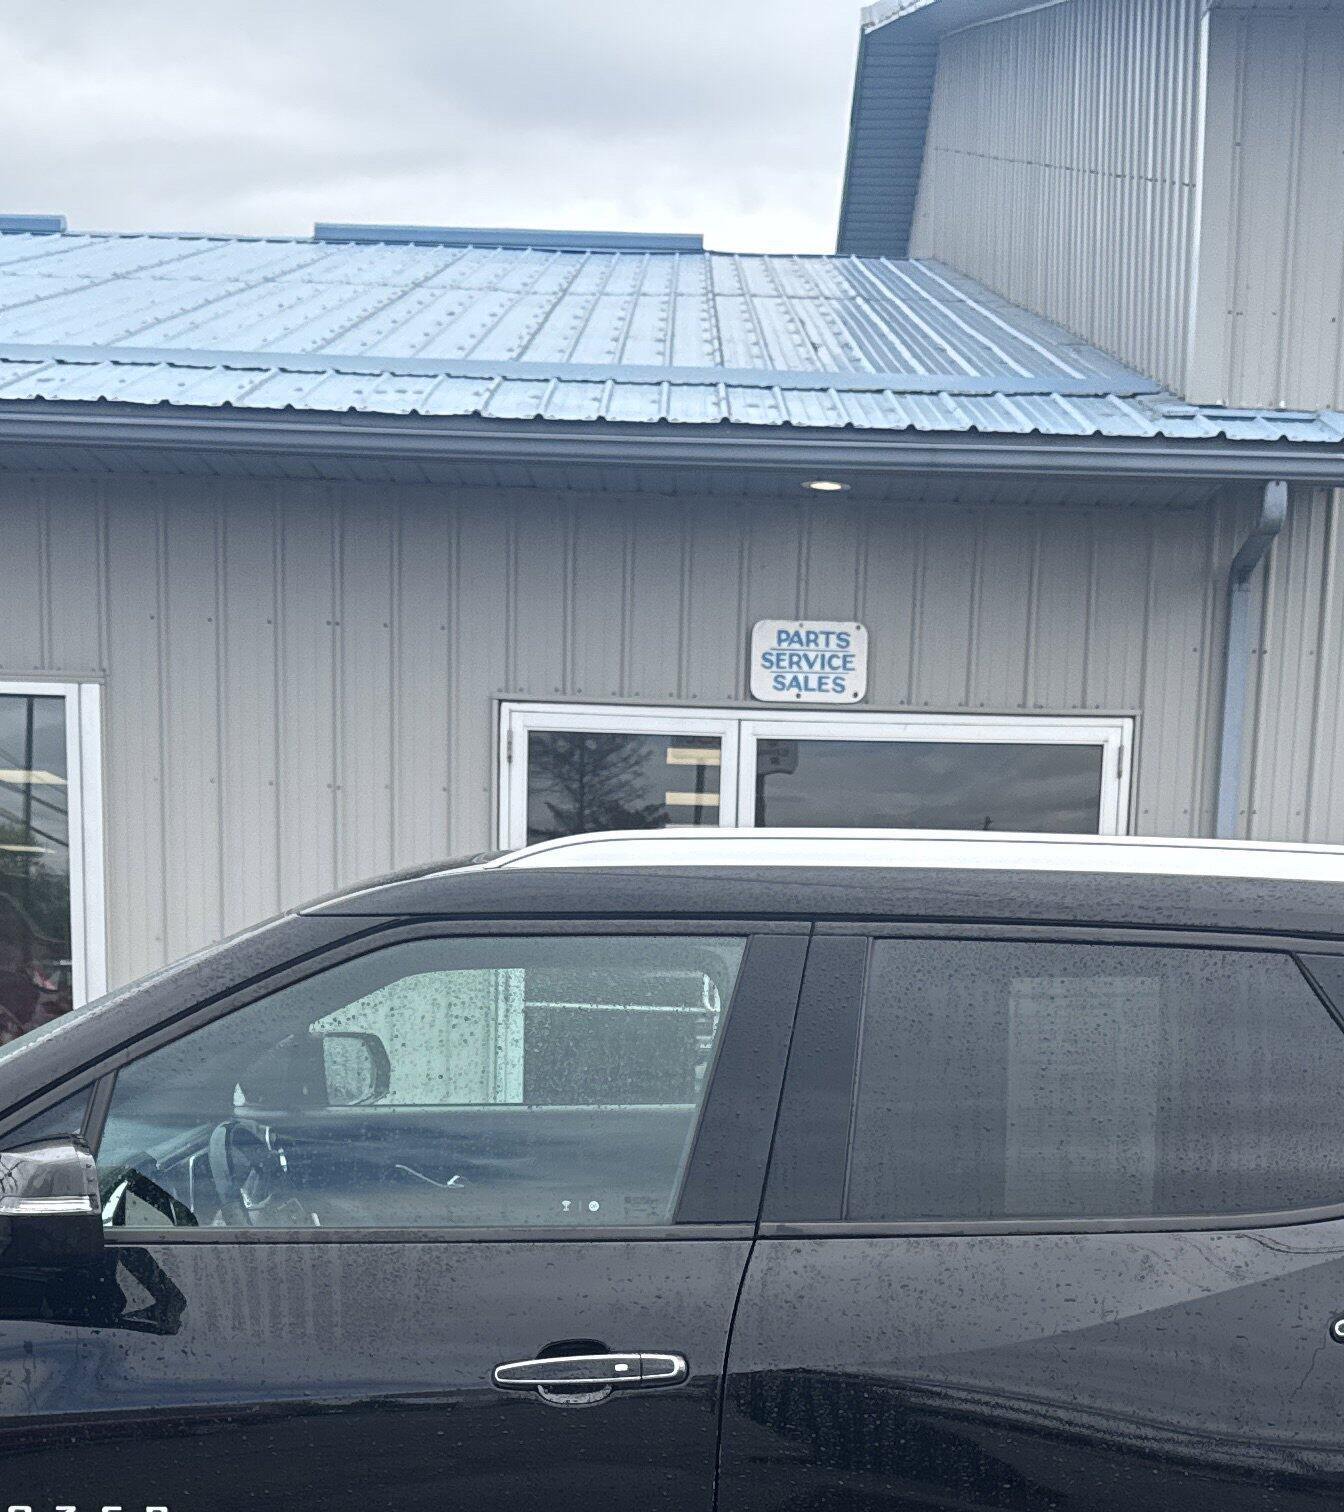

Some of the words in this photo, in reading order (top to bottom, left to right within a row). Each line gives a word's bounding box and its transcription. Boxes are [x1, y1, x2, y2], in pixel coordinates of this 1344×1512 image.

[777, 629, 851, 649] PARTS
[761, 651, 856, 671] SERVICE
[772, 674, 846, 694] SALES
